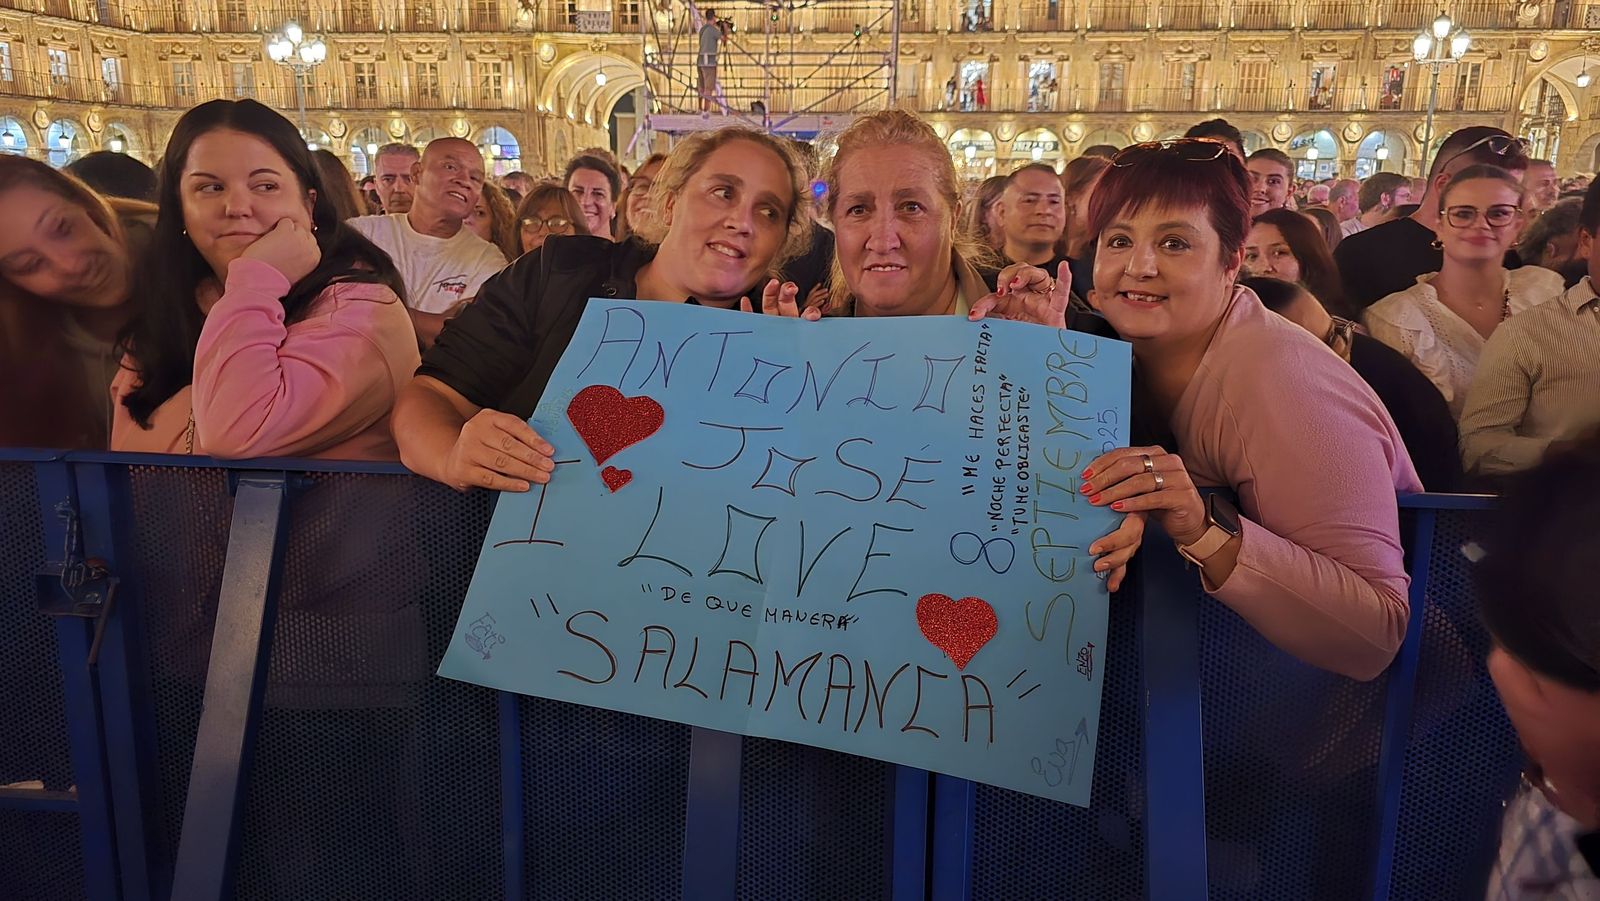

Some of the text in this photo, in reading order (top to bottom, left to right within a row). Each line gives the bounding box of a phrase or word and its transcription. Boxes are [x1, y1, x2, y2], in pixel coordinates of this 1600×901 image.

[577, 306, 966, 414] ANTONIO
[968, 384, 985, 439] HACES
[1097, 407, 1118, 455] 025.
[681, 421, 942, 509] JOSÉ
[1026, 328, 1098, 665] SEPTIEMBRE
[493, 459, 914, 602] I LOVE
[950, 531, 1015, 574] 8
[705, 596, 752, 617] QUE
